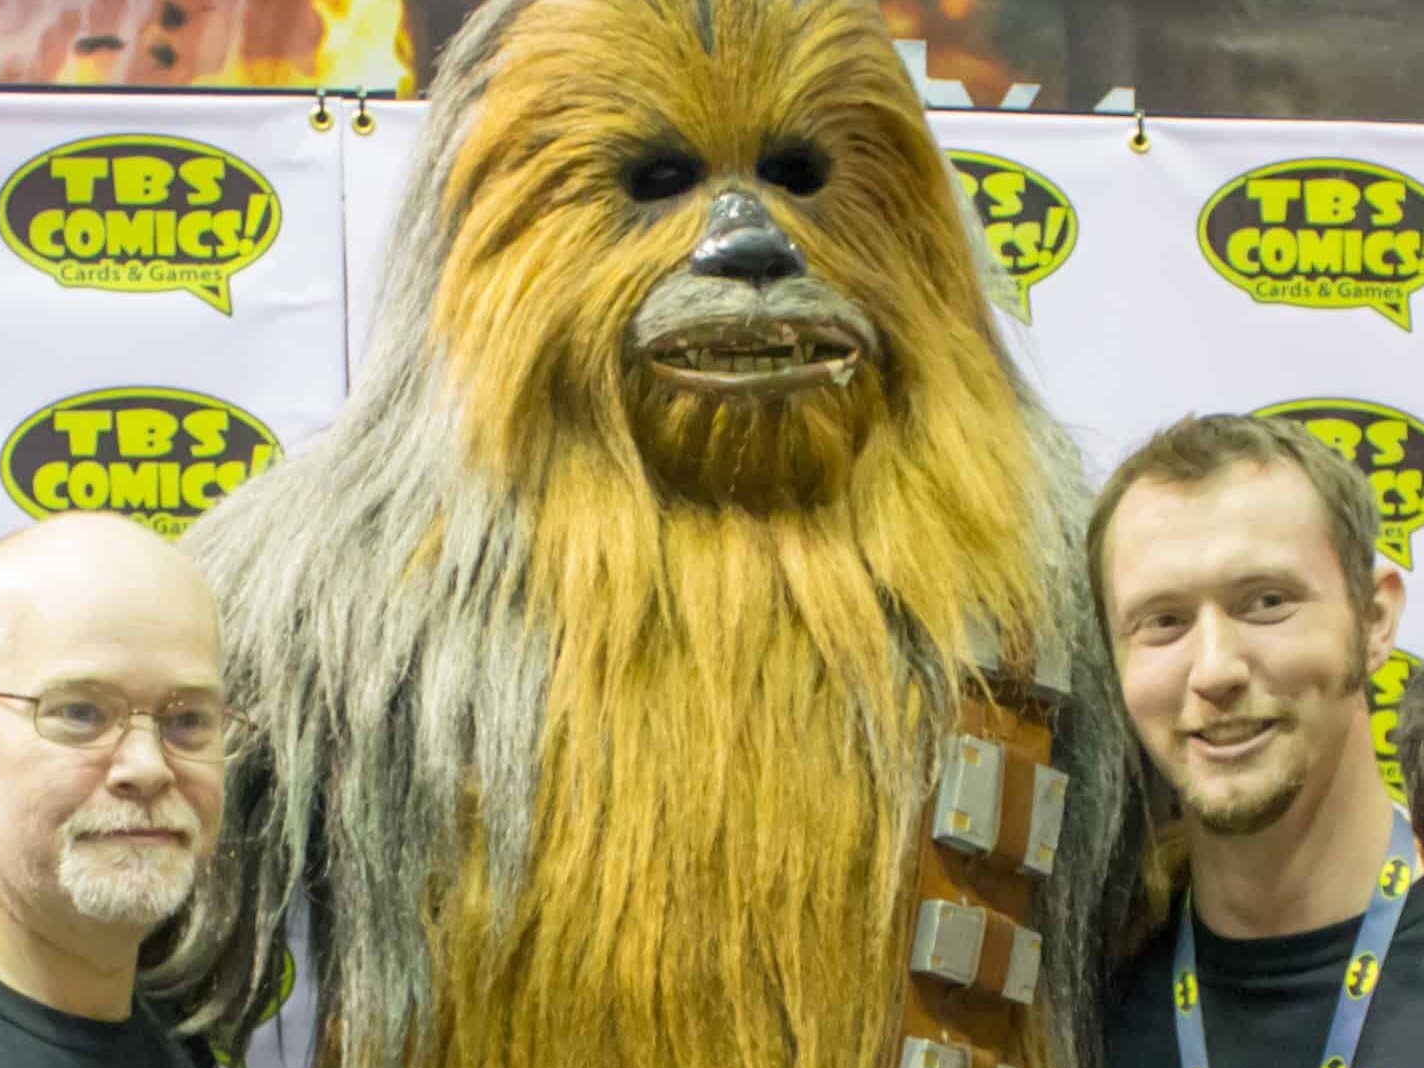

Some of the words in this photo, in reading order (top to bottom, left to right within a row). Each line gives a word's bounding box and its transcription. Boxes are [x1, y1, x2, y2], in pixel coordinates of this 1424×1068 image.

[49, 155, 226, 205] TBS
[1246, 178, 1406, 226] TBS
[28, 192, 269, 258] COMICS!
[60, 263, 121, 283] Cards
[127, 263, 143, 283] &
[149, 264, 223, 283] Games
[1255, 280, 1310, 299] Cards
[1316, 280, 1331, 299] &
[1336, 281, 1403, 300] Games
[53, 407, 229, 457] TBS
